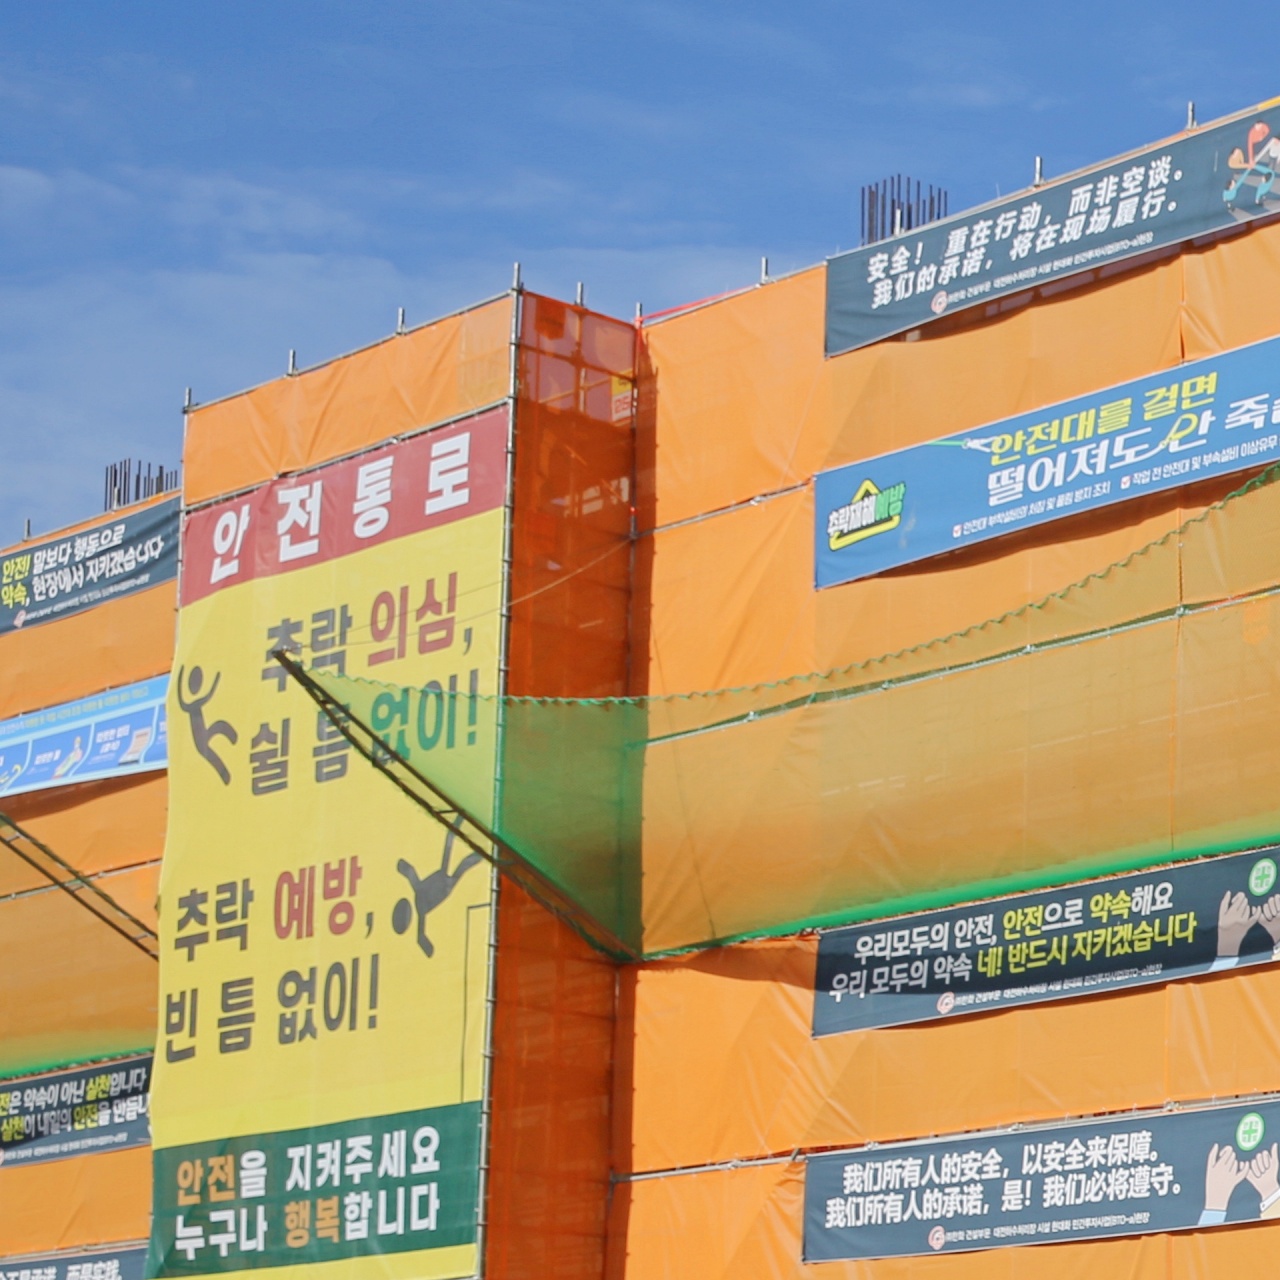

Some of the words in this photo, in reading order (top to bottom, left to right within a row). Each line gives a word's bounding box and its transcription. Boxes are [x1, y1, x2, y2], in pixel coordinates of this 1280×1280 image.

[991, 397, 1132, 466] 안전대를
[1144, 371, 1218, 421] 걸면
[1162, 459, 1189, 480] 안전대
[1240, 434, 1278, 457] 이상유무
[987, 426, 1157, 508] 떨어져도
[828, 481, 906, 537] 추락재해예방
[2, 554, 31, 584] 안전!
[33, 541, 73, 576] 말보다
[74, 523, 126, 563] 행동으로
[32, 562, 84, 602] 현장에서
[86, 534, 165, 583] 지키겠습니다
[260, 603, 352, 694] 추락
[367, 571, 474, 664] 의심,
[250, 719, 290, 797] 쉴
[314, 709, 354, 784] 틈
[370, 667, 480, 768] 없이!
[173, 877, 255, 963] 추락
[274, 854, 375, 943] 예방,
[854, 921, 950, 967] 우리모두의
[952, 915, 999, 951] 안전,
[1002, 897, 1083, 939] 안전으로
[1088, 881, 1174, 924] 약속해요
[828, 969, 866, 1004] 우리
[868, 960, 929, 997] 모두의
[932, 951, 974, 986] 약속
[976, 942, 1003, 977] 네!
[1006, 934, 1068, 974] 반드시
[1071, 912, 1199, 963] 지키겠습니다
[165, 990, 198, 1066] 빈
[217, 979, 256, 1055] 틈
[277, 962, 379, 1043] 없이!
[1, 1113, 35, 1142] 실천이
[37, 1107, 72, 1136] 내일의
[73, 1100, 111, 1131] 안전을
[112, 1093, 150, 1125] 만듭니
[23, 1083, 59, 1112] 약속이
[60, 1078, 86, 1105] 아닌
[85, 1067, 147, 1101] 실천입니다
[176, 1149, 268, 1208] 안전을
[287, 1125, 441, 1193] 지켜주세요
[175, 1206, 268, 1261] 누구나
[284, 1182, 441, 1250] 행복합니다
